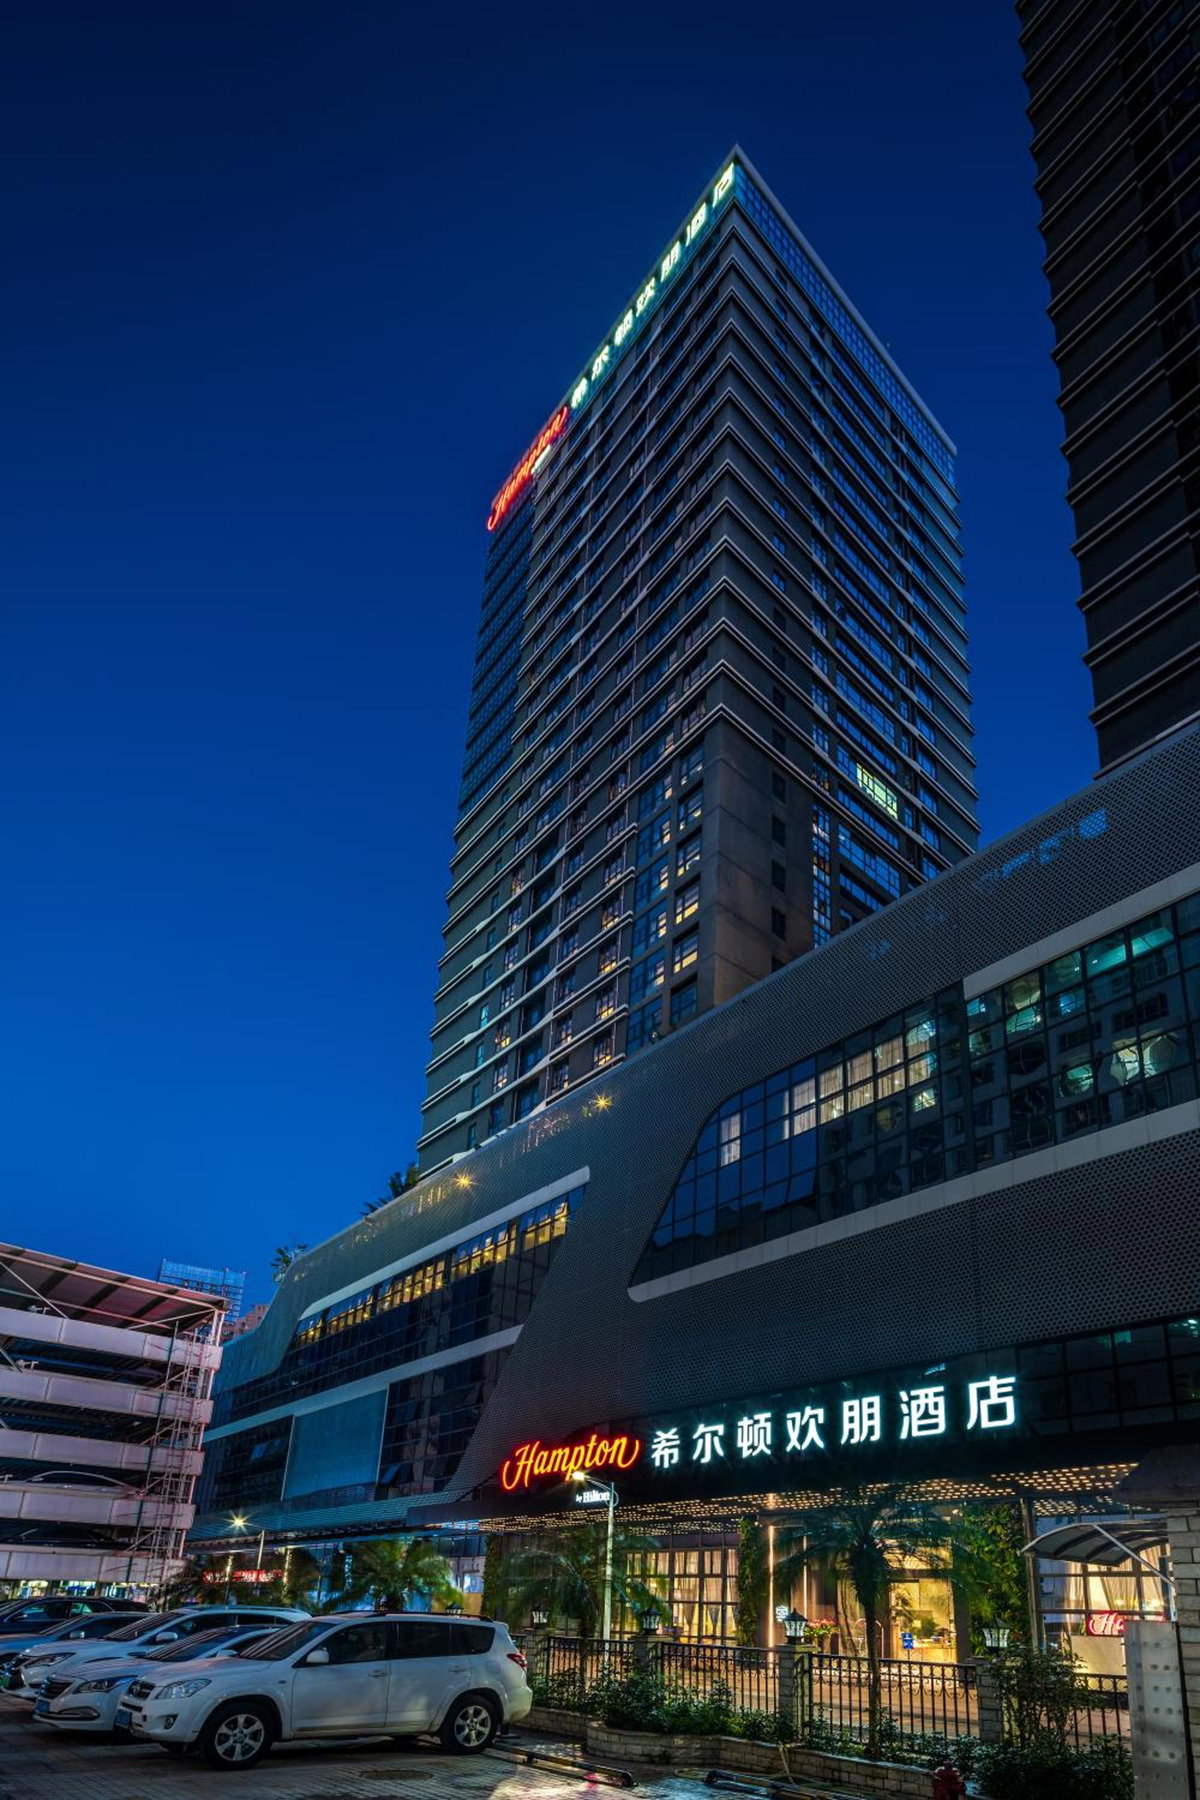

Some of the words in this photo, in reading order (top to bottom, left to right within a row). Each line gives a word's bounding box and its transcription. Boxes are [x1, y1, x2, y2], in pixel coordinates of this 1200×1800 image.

[651, 1376, 1016, 1469] 希尔顿欢朋酒店
[502, 1434, 640, 1490] Hampton
[583, 1490, 611, 1503] Hilton
